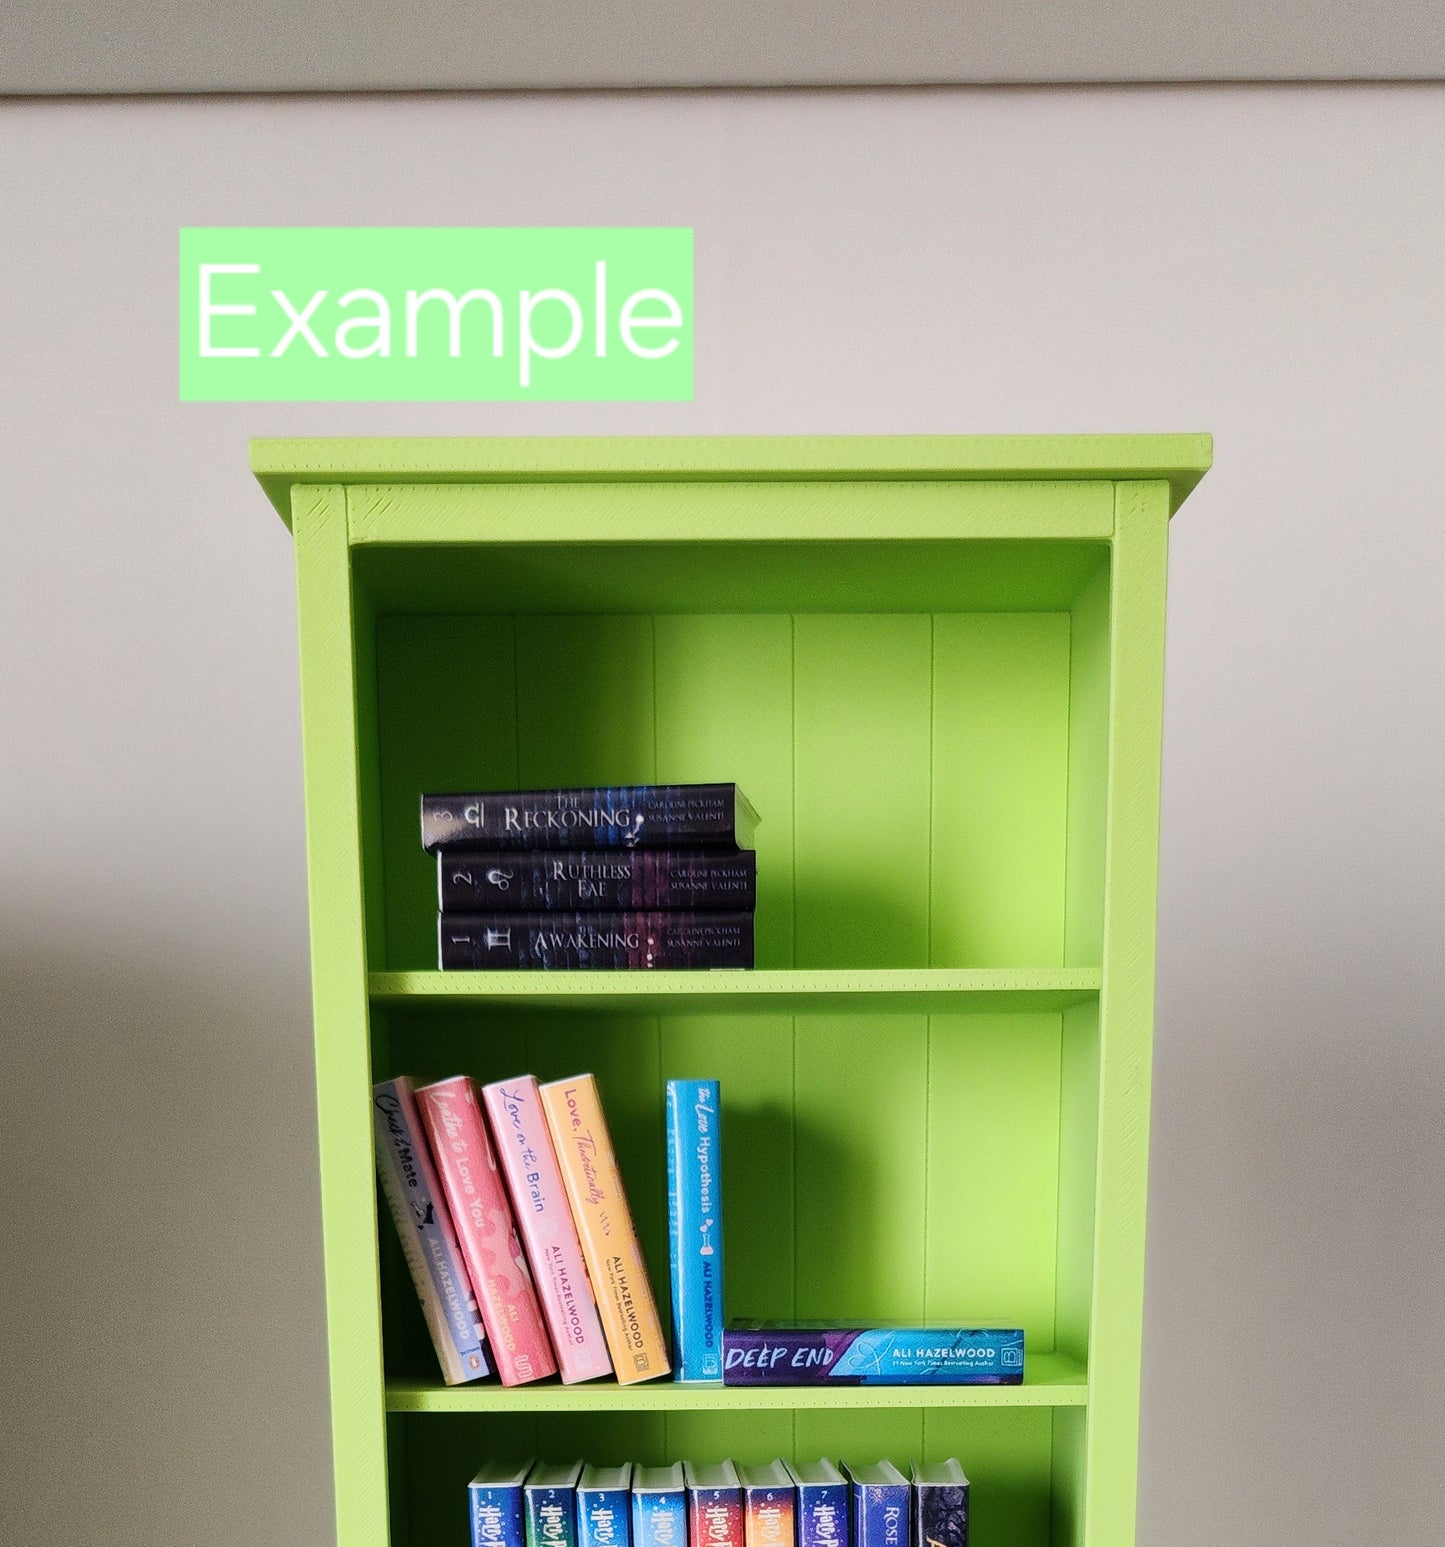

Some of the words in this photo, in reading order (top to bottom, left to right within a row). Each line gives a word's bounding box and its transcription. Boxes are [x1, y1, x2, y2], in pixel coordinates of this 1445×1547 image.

[504, 809, 630, 831] RECKONING
[553, 861, 632, 881] RUTHLESS
[578, 880, 607, 897] FAE
[534, 933, 639, 951] AWAKENING
[499, 1088, 526, 1130] Love
[564, 1088, 584, 1132] Love,
[695, 1103, 714, 1134] Love
[516, 1133, 528, 1147] on
[398, 1149, 418, 1188] Mate
[521, 1147, 538, 1172] the
[695, 1137, 711, 1213] Hypothesis
[456, 1157, 480, 1195] Love
[468, 1199, 486, 1229] You
[526, 1171, 546, 1214] Brain
[611, 1256, 625, 1274] ALI
[437, 1261, 470, 1340] HAZELWOOD
[551, 1245, 563, 1265] ALI
[557, 1268, 585, 1345] HAZELWOOD
[617, 1276, 644, 1349] HAZELWOOD
[703, 1281, 714, 1348] HAZELWOOD
[724, 1348, 788, 1371] DEEP
[791, 1347, 834, 1367] END
[892, 1348, 911, 1358] ALI
[916, 1348, 996, 1358] HAZELWOOD
[486, 1491, 492, 1499] 1
[548, 1490, 556, 1498] 2
[598, 1493, 605, 1502] 3
[658, 1497, 666, 1505] 4
[713, 1491, 720, 1499] 5
[766, 1492, 773, 1501] 6
[821, 1490, 828, 1499] 7
[480, 1506, 502, 1542] Harry
[541, 1505, 563, 1538] Harry
[592, 1510, 613, 1544] Harry
[653, 1511, 676, 1545] Harry
[707, 1507, 730, 1541] Harry
[759, 1509, 781, 1543] Harry
[814, 1505, 835, 1540] Harry
[884, 1506, 899, 1545] ROSE
